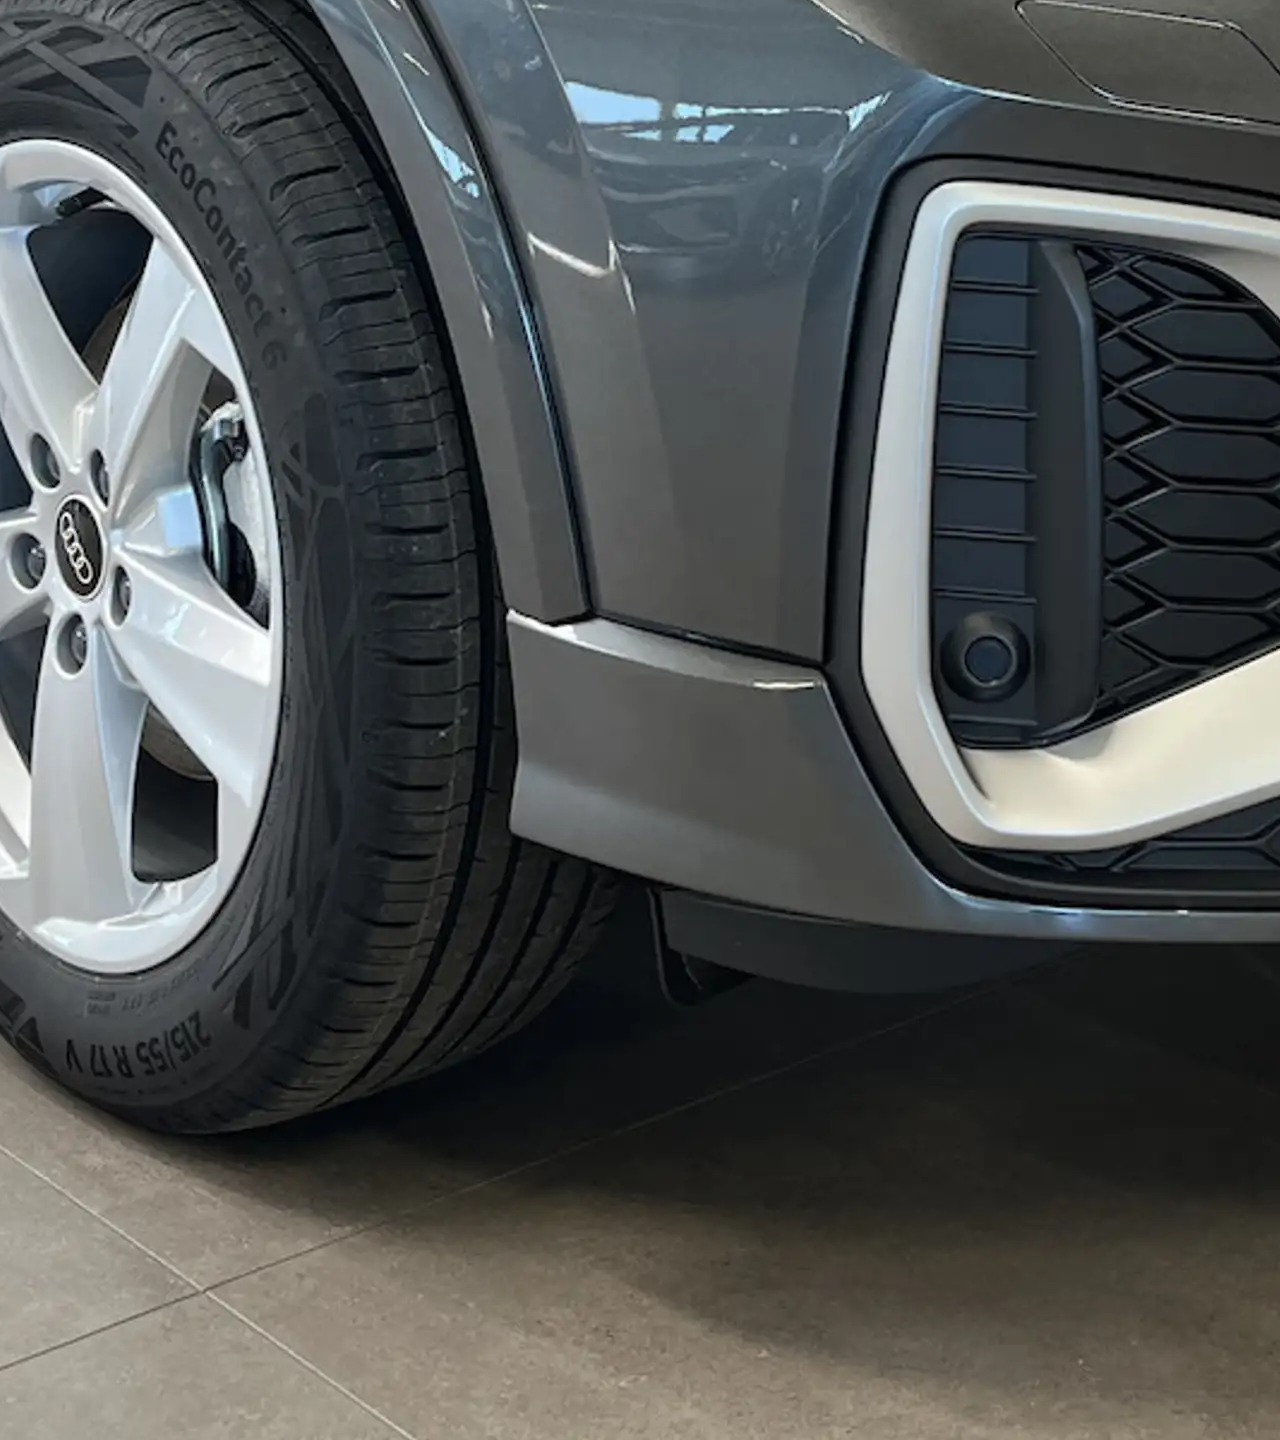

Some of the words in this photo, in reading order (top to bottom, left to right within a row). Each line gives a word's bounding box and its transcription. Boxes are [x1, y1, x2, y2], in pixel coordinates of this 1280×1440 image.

[155, 120, 274, 337] EcoContact
[66, 1038, 84, 1074] V
[135, 1010, 213, 1076] 215/55
